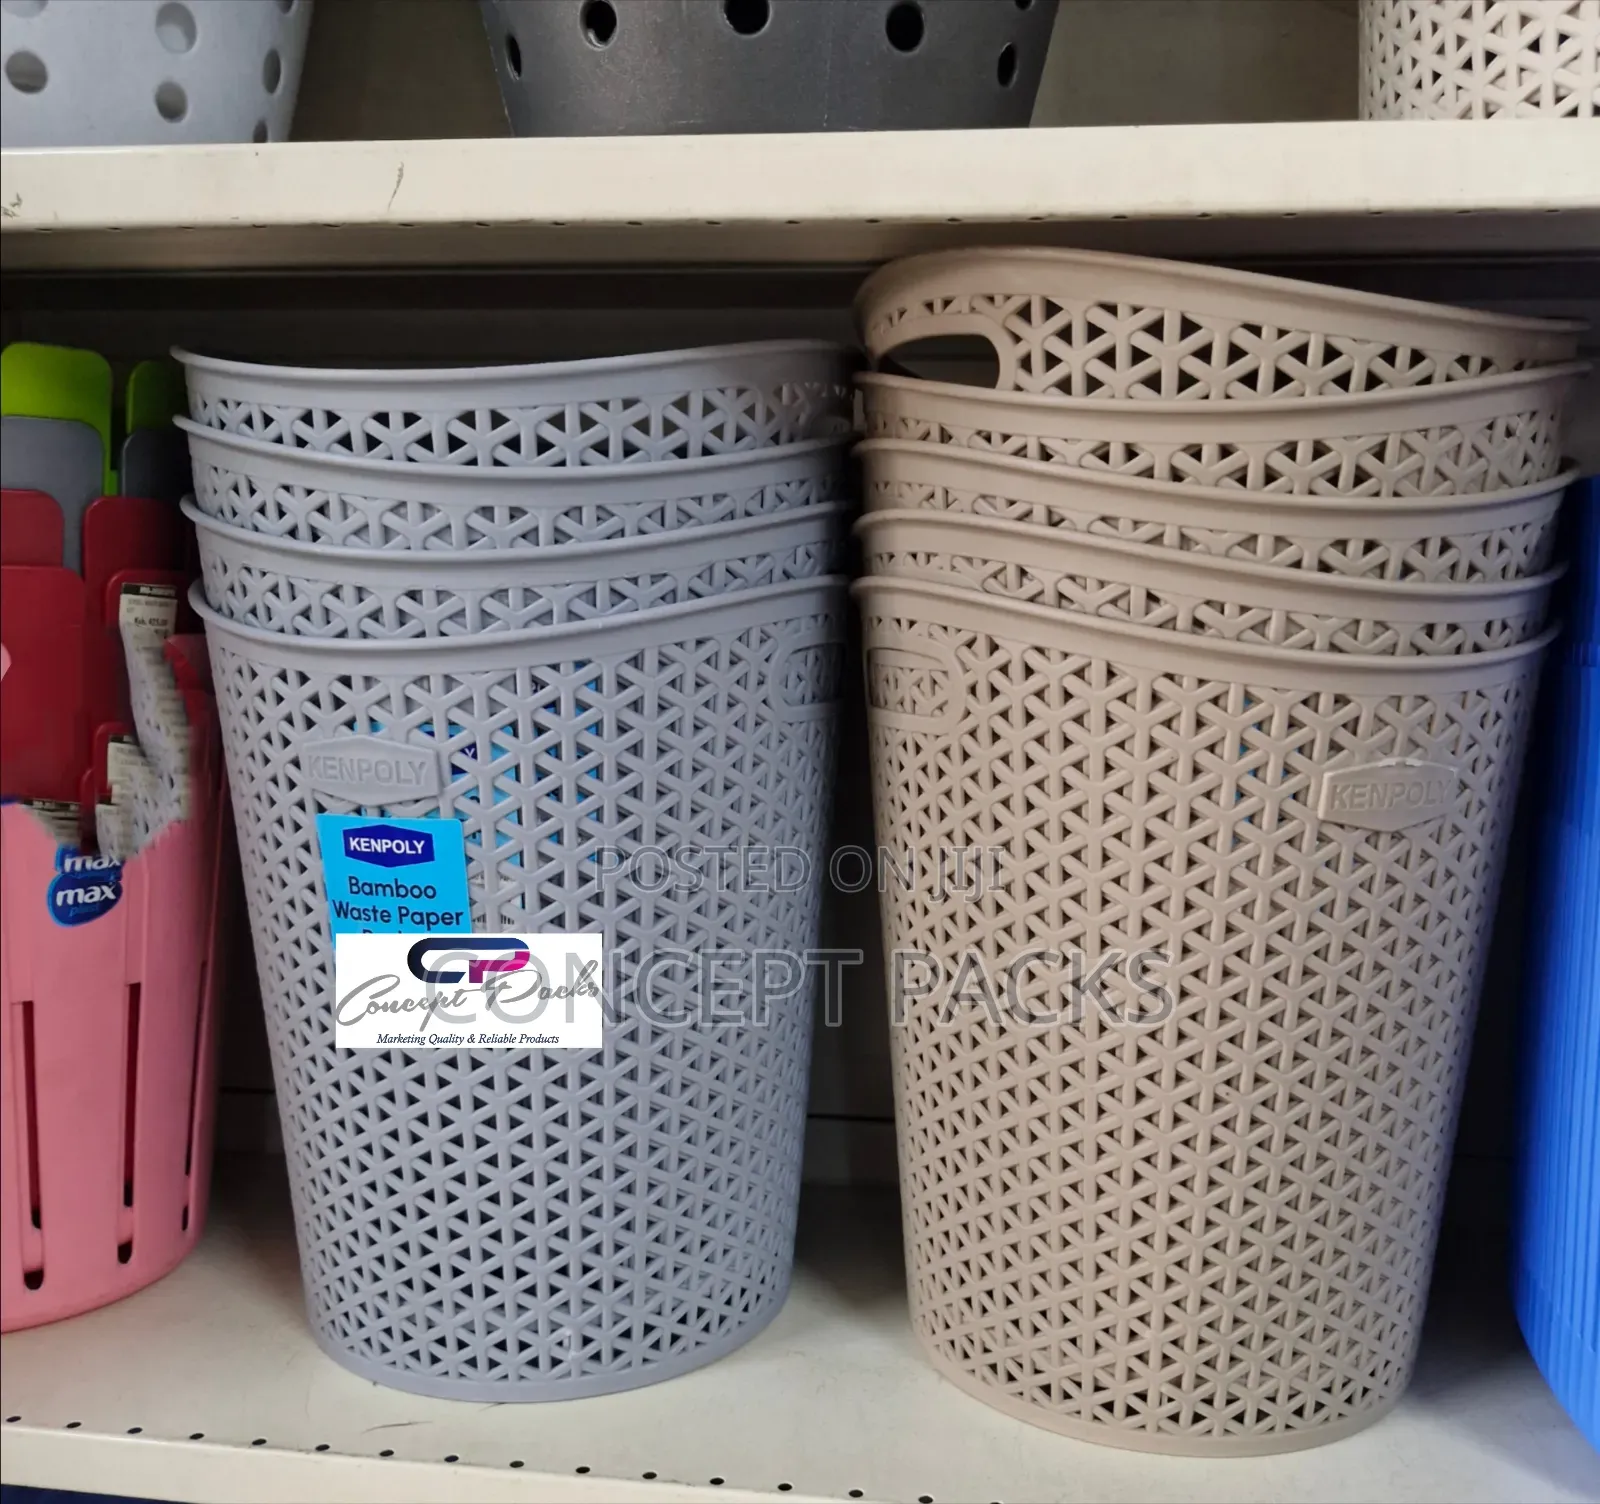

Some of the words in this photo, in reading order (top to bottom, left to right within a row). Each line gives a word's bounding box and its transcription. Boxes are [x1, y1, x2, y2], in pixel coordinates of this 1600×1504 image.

[307, 755, 427, 785] KENPOLY
[1330, 779, 1451, 811] KENPOLY
[348, 836, 425, 855] KENPOLY
[64, 852, 121, 873] max
[56, 884, 117, 907] max
[348, 875, 437, 899] Bamboo
[332, 899, 392, 923] Waste
[397, 905, 465, 931] Paper
